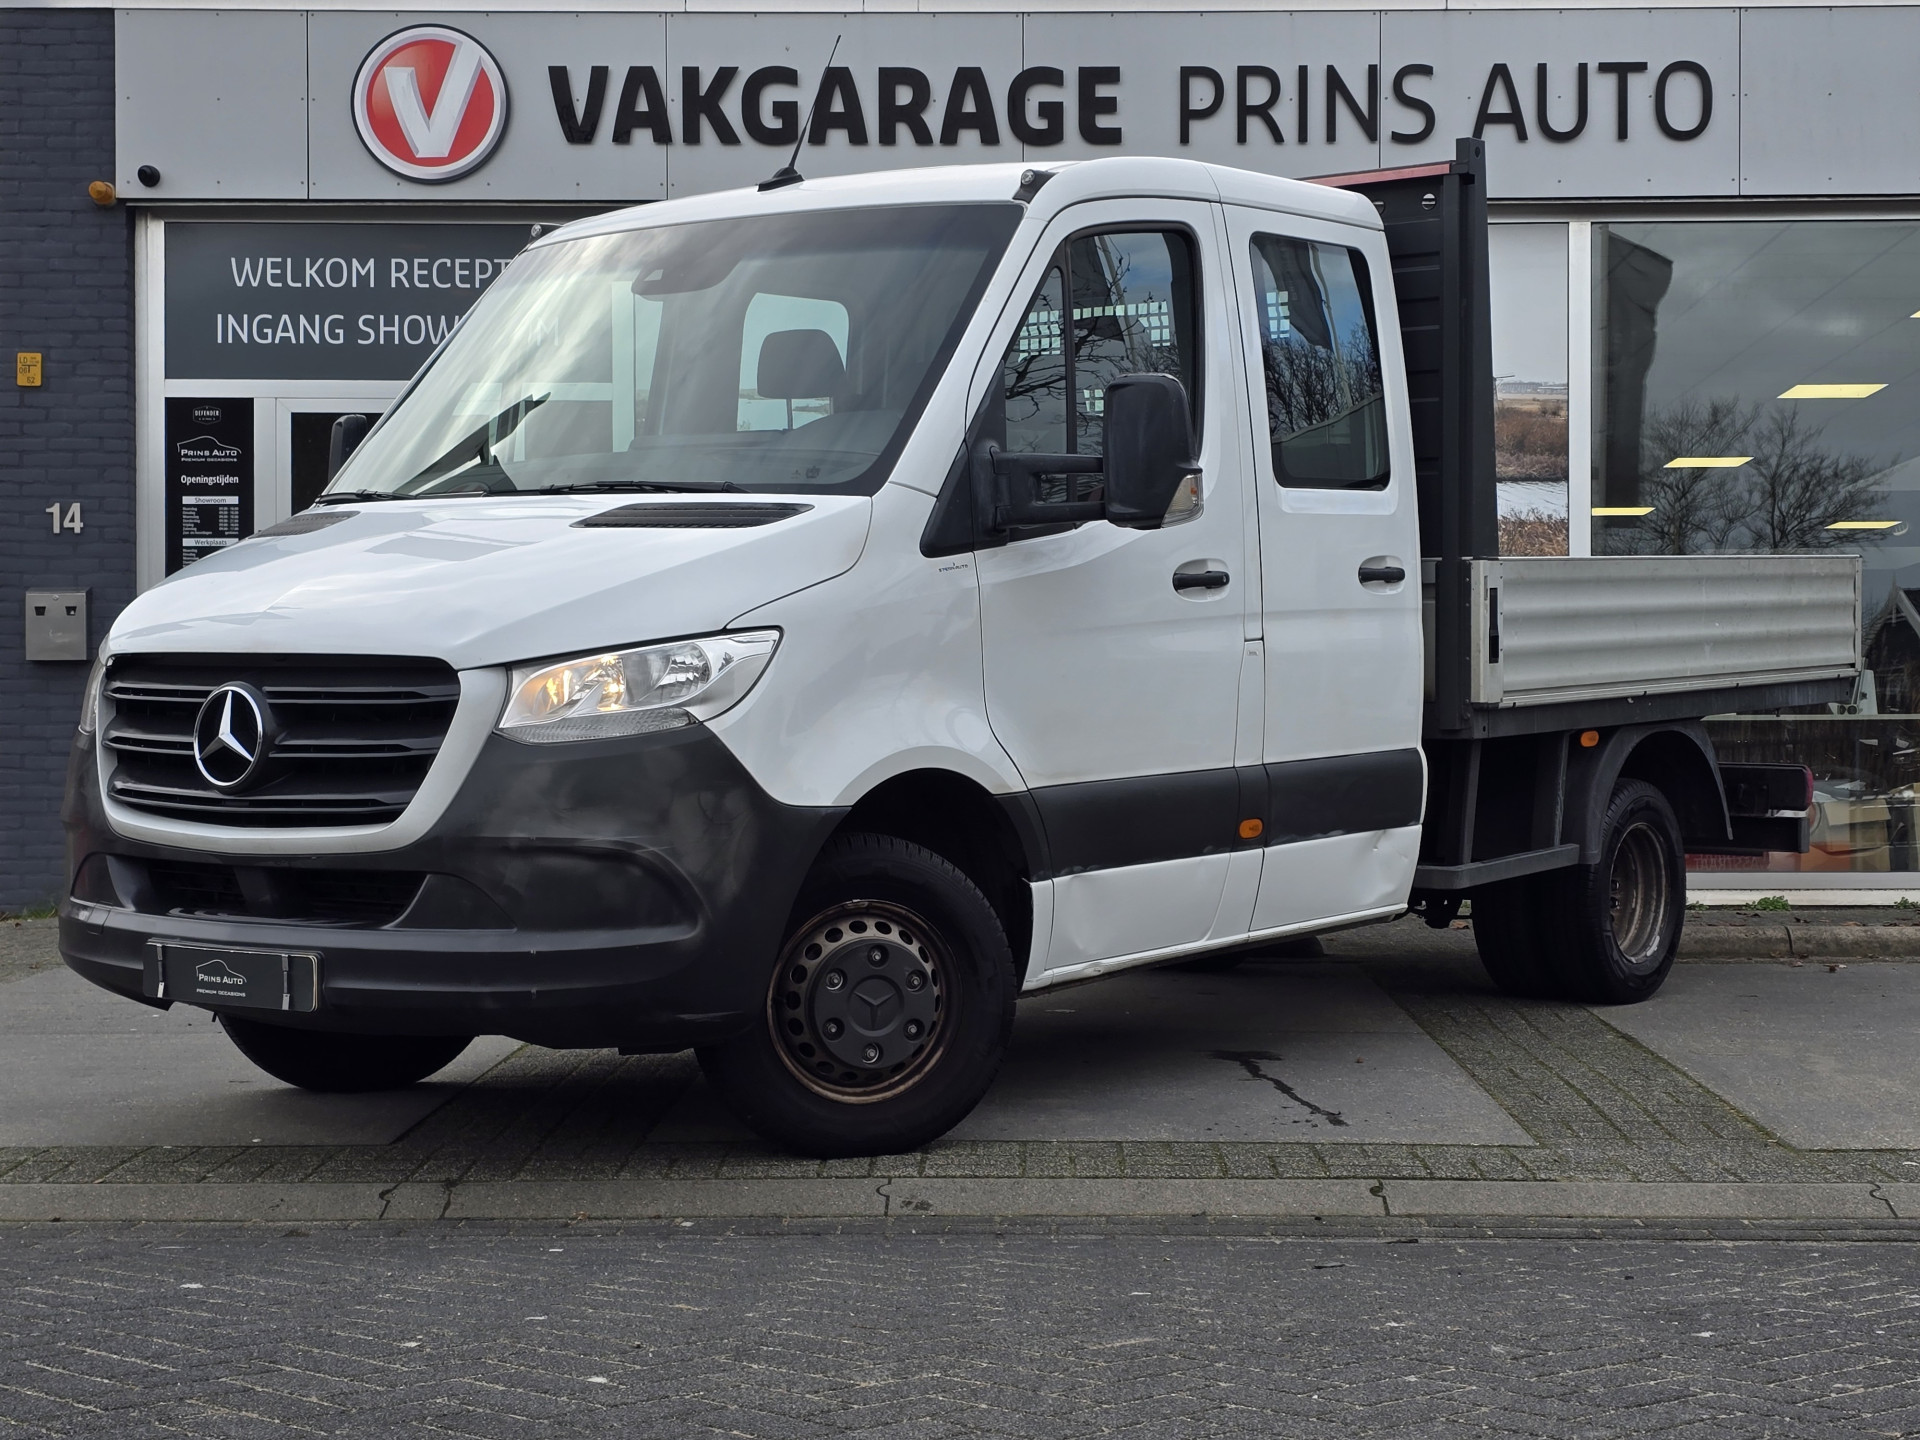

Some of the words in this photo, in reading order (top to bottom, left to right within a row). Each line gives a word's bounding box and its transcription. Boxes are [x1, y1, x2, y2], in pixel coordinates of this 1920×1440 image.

[547, 65, 1122, 146] VAKGARAGE
[1179, 63, 1436, 146] PRINS
[1471, 60, 1713, 142] AUTO
[230, 257, 375, 288] WELKOM
[216, 313, 345, 345] INGANG
[181, 449, 210, 457] PRINS
[181, 475, 238, 485] Openingstijden
[45, 502, 83, 534] 14
[194, 539, 228, 547] Werkplaats
[199, 974, 220, 983] PRINS
[223, 975, 243, 984] AUTO
